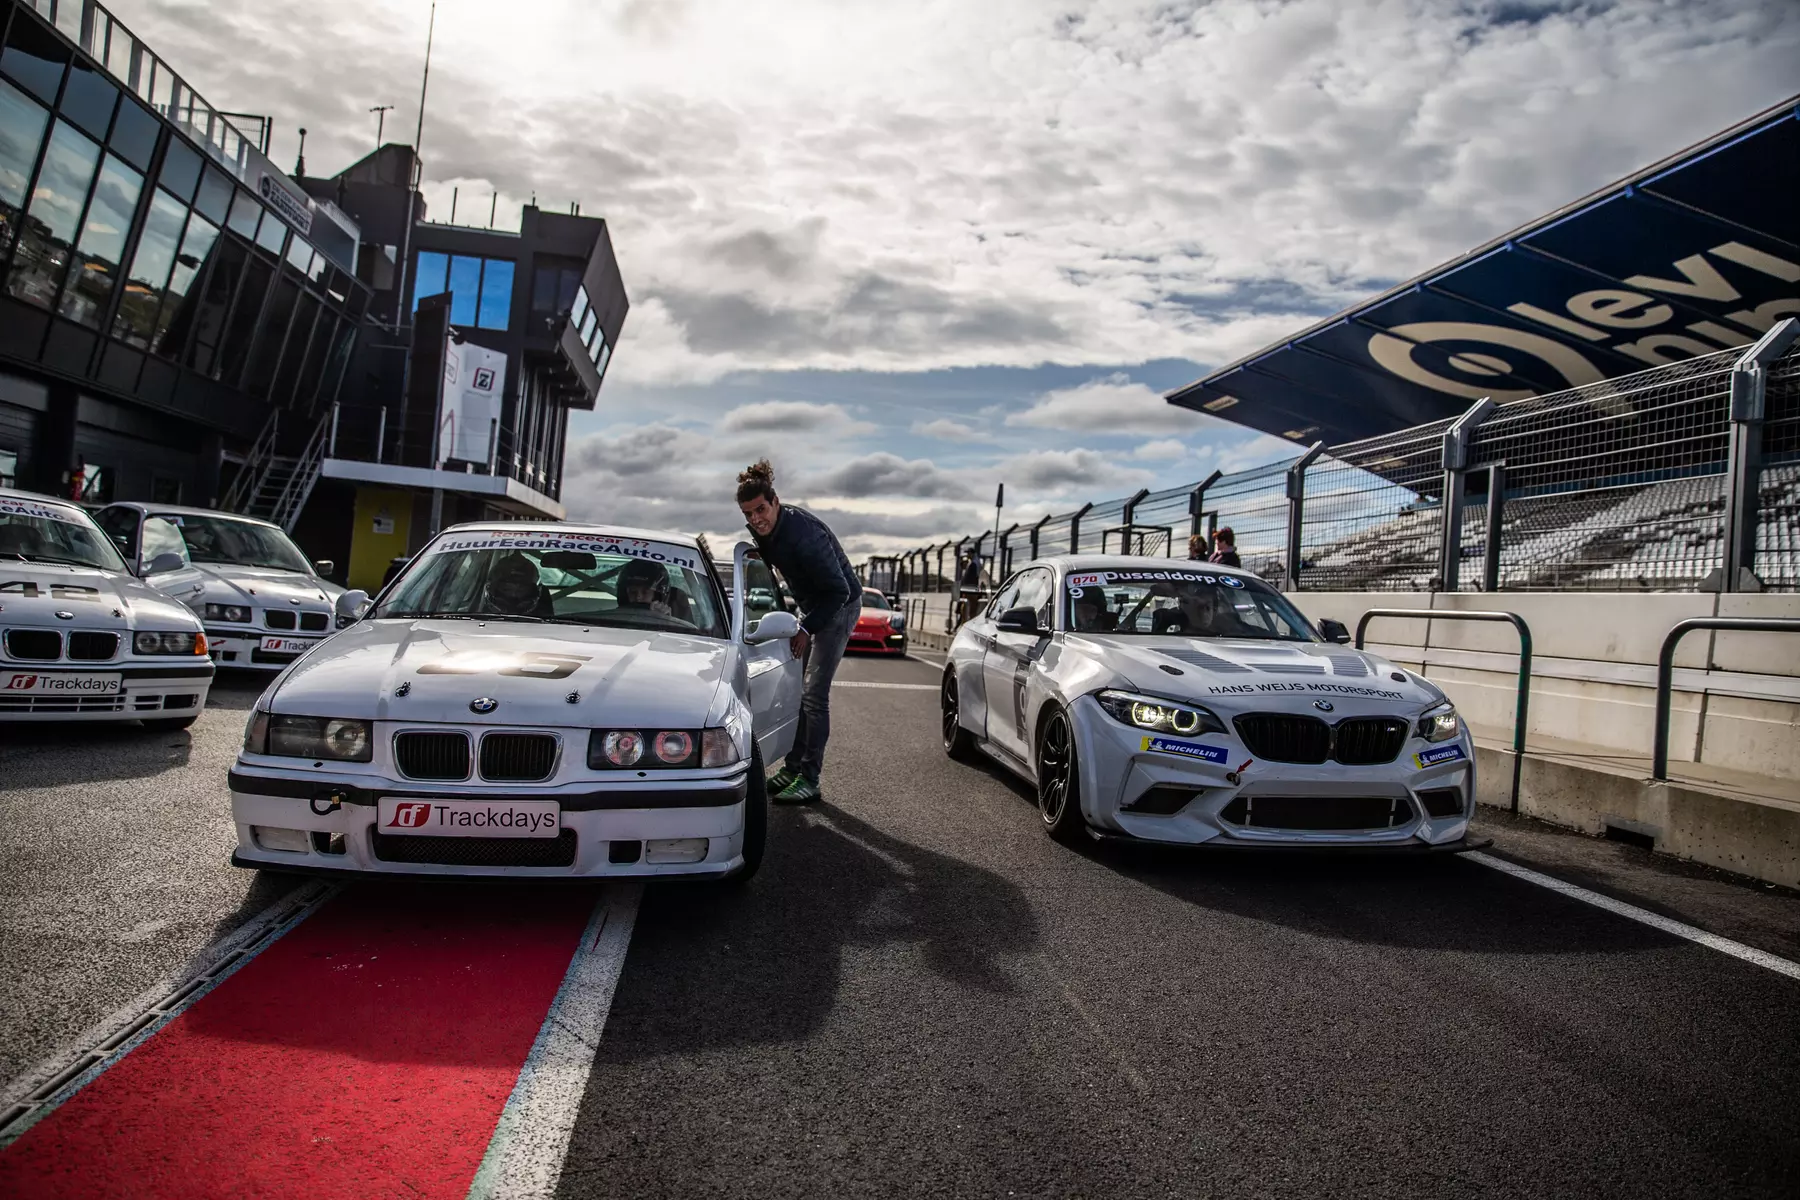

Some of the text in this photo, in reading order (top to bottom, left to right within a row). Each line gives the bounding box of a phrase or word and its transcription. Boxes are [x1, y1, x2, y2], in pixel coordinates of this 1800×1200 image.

[558, 533, 623, 544] racecar
[631, 540, 650, 549] ??
[439, 538, 695, 569] HuurEenRaceAuto.nl
[1103, 571, 1217, 585] Dusseldorp
[1069, 587, 1084, 599] 9
[40, 676, 118, 692] Trackdays
[1208, 682, 1404, 700] HANS WEIJS MOTORSPORT
[1165, 744, 1218, 758] MICHELIN
[1429, 749, 1459, 761] MICHELIN
[434, 806, 555, 833] Trackdays
